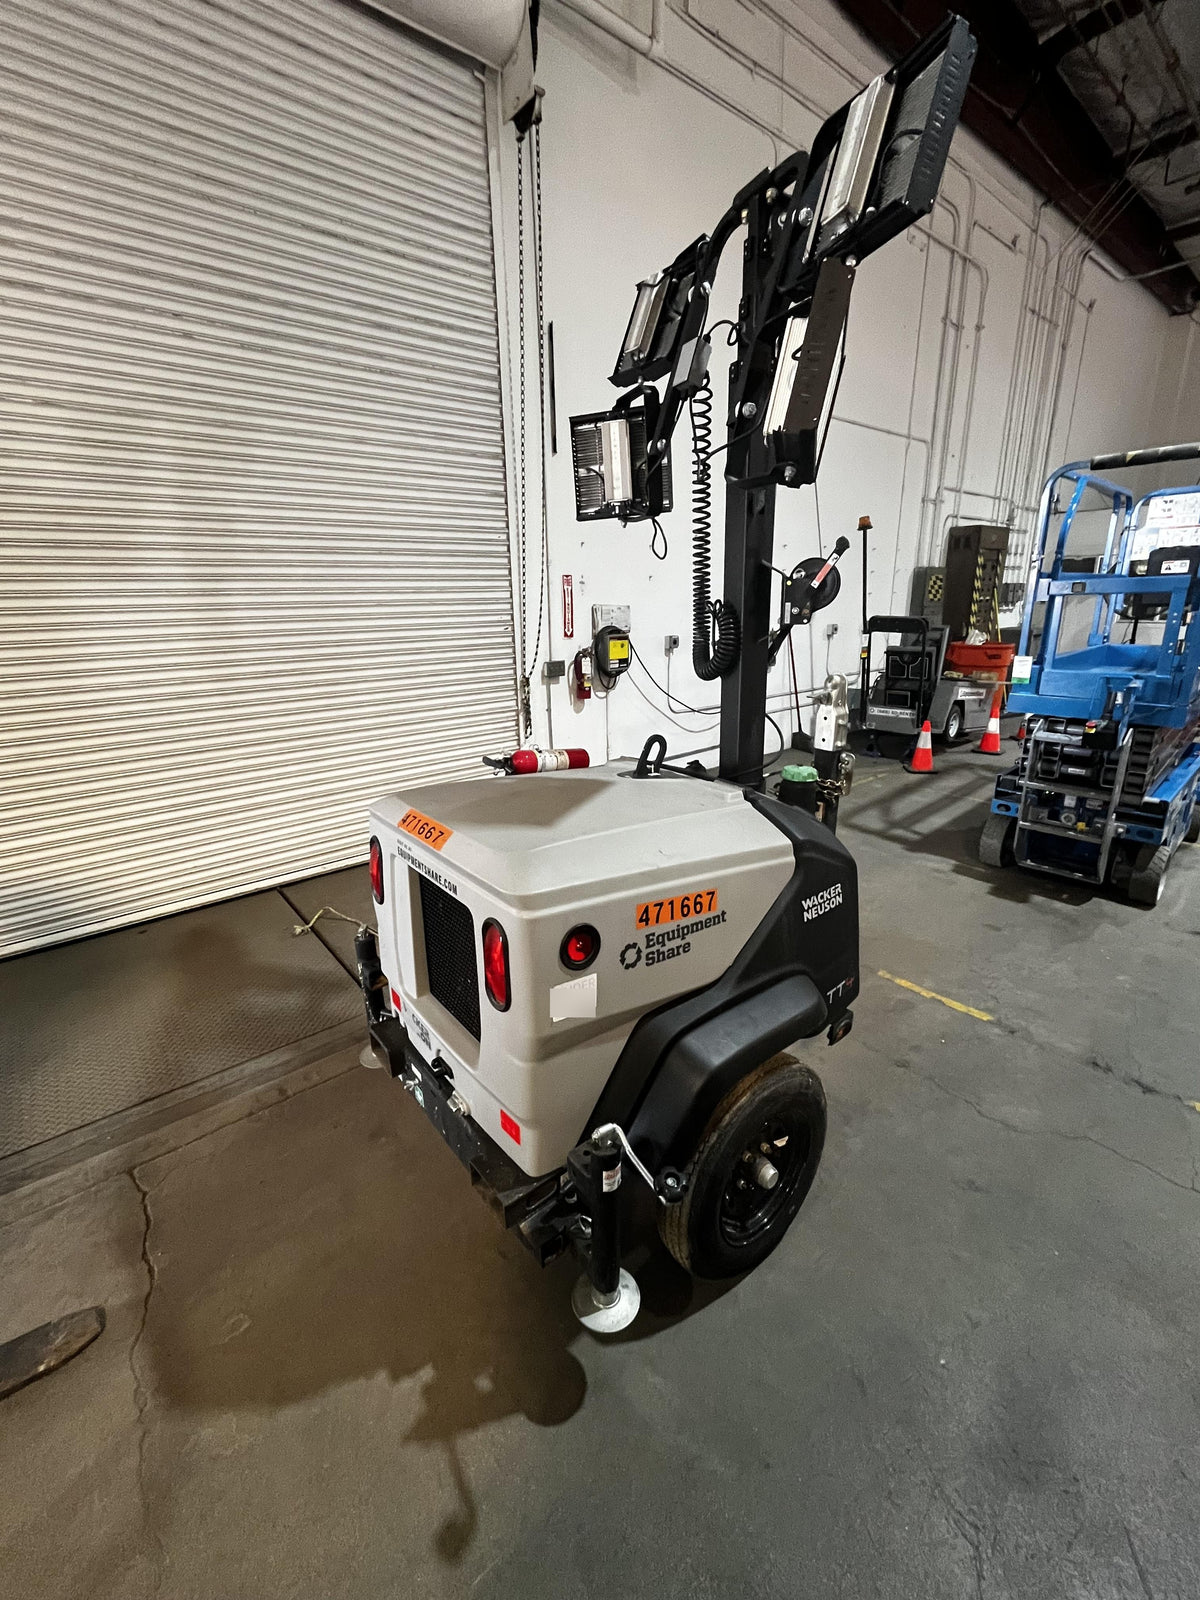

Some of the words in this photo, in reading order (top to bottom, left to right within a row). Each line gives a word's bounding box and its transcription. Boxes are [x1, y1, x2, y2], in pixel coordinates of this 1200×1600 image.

[401, 813, 445, 843] 471667
[397, 846, 458, 896] EQUIPMENTSHARE.COM
[638, 890, 717, 927] 471667
[801, 883, 842, 911] WACKER
[803, 893, 843, 923] NEUSON
[644, 909, 727, 950] Equipment
[645, 940, 691, 968] Share
